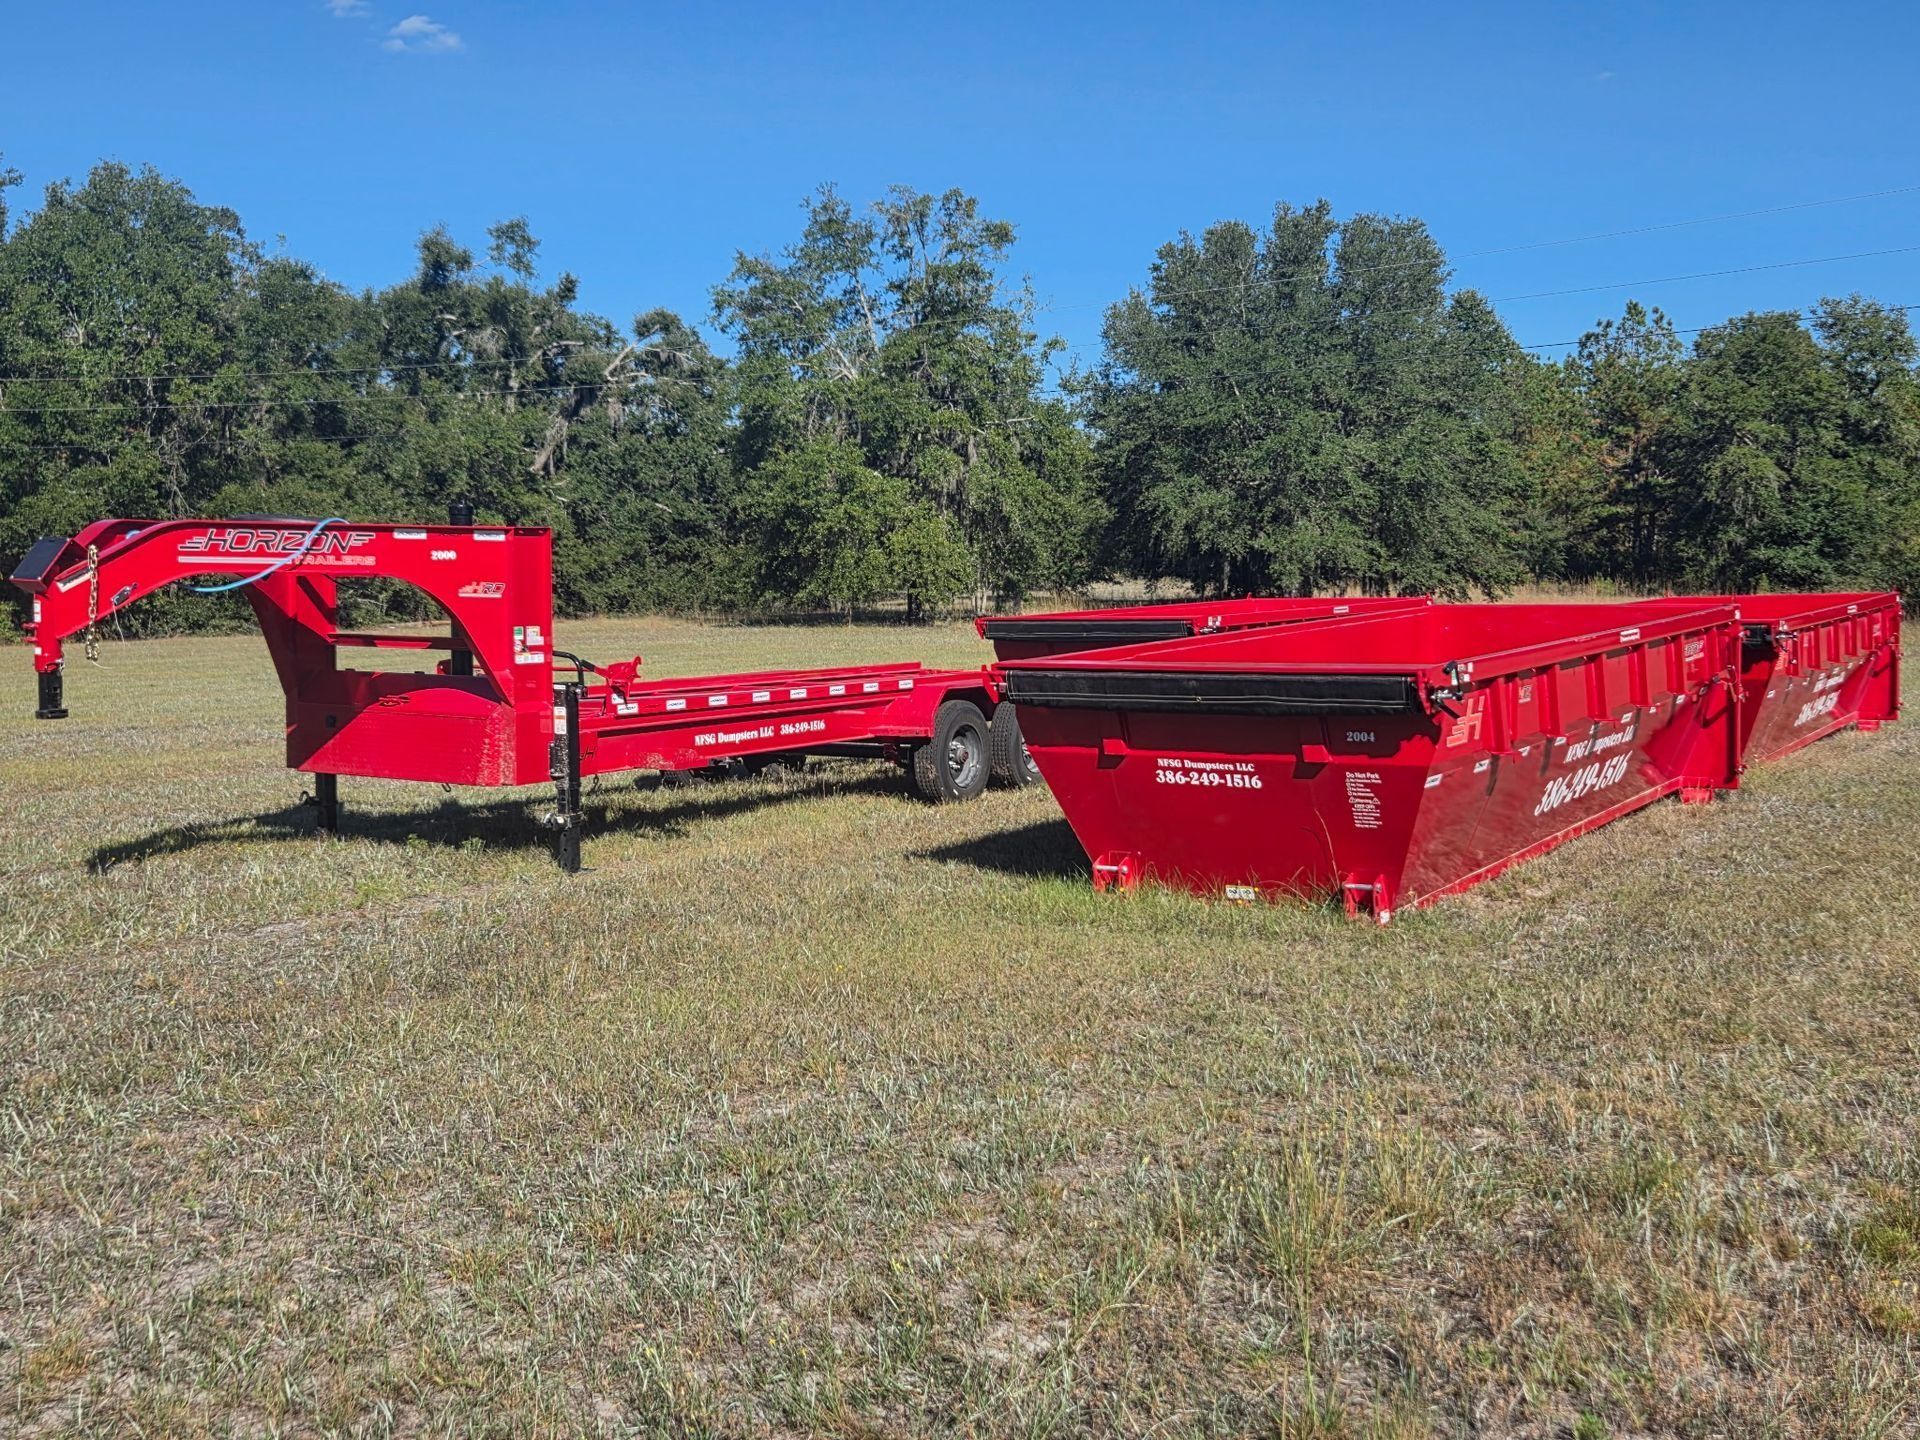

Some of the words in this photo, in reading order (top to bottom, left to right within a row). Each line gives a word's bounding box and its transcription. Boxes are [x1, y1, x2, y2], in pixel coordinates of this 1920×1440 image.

[203, 528, 352, 553] HORIZON
[294, 554, 376, 566] TRAILERS
[430, 550, 457, 560] 2000
[694, 733, 717, 746] NFSG
[717, 730, 759, 744] Dumpsters
[759, 726, 775, 738] LLC
[780, 720, 826, 736] 386-249-1516
[1346, 731, 1375, 742] 2004
[1157, 758, 1182, 768] NFSG
[1184, 759, 1234, 771] Dumpsters
[1236, 762, 1255, 772] LLC
[1155, 769, 1262, 789] 386-249-1516
[1534, 750, 1633, 816] 386-249-1516
